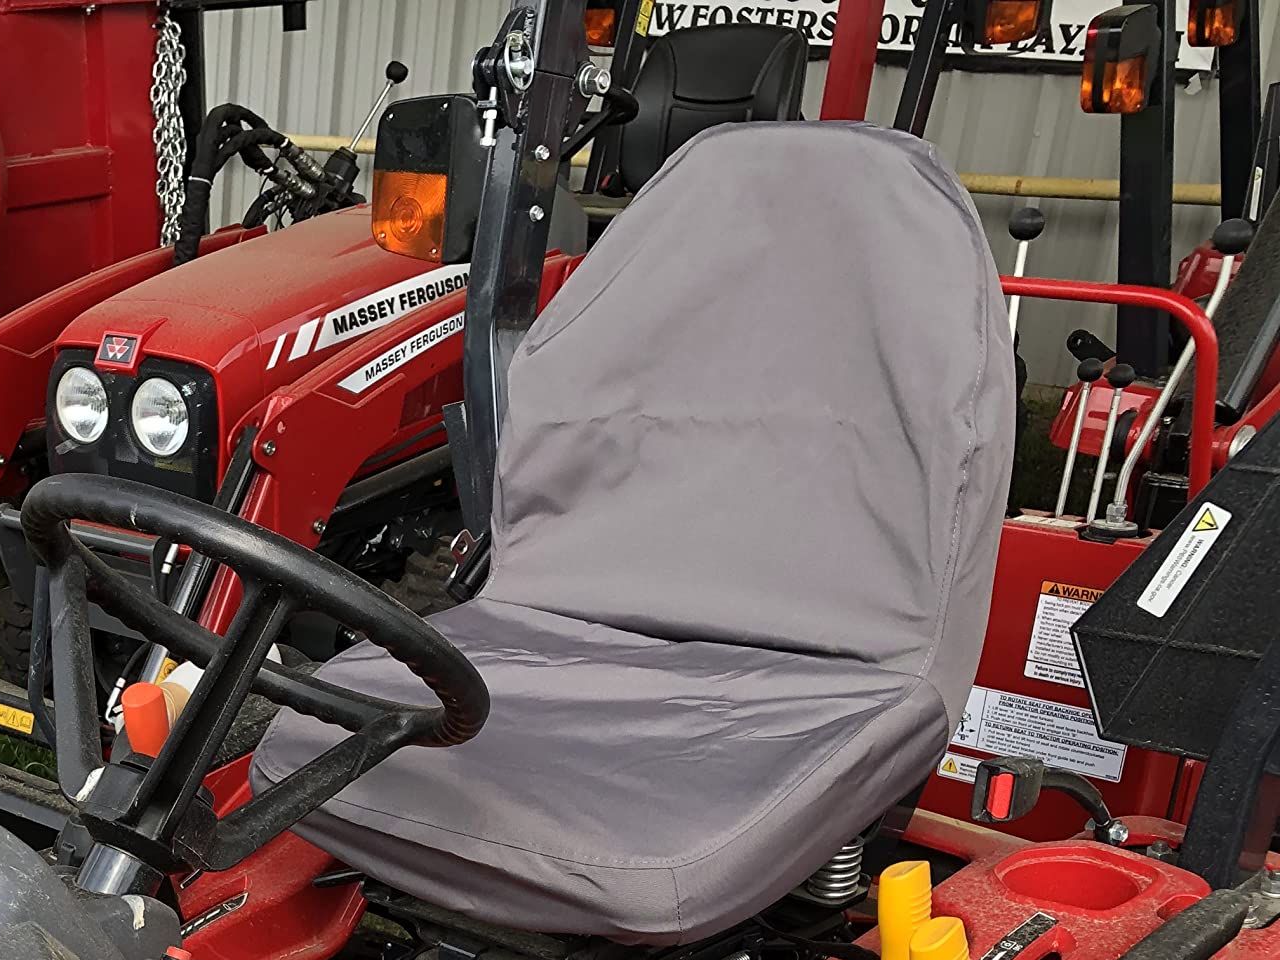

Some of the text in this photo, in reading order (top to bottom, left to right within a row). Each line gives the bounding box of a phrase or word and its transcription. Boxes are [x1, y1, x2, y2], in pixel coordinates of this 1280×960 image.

[332, 297, 395, 336] MASSEY
[365, 316, 463, 381] MASSEY FERGUSON
[1062, 586, 1102, 600] WARN
